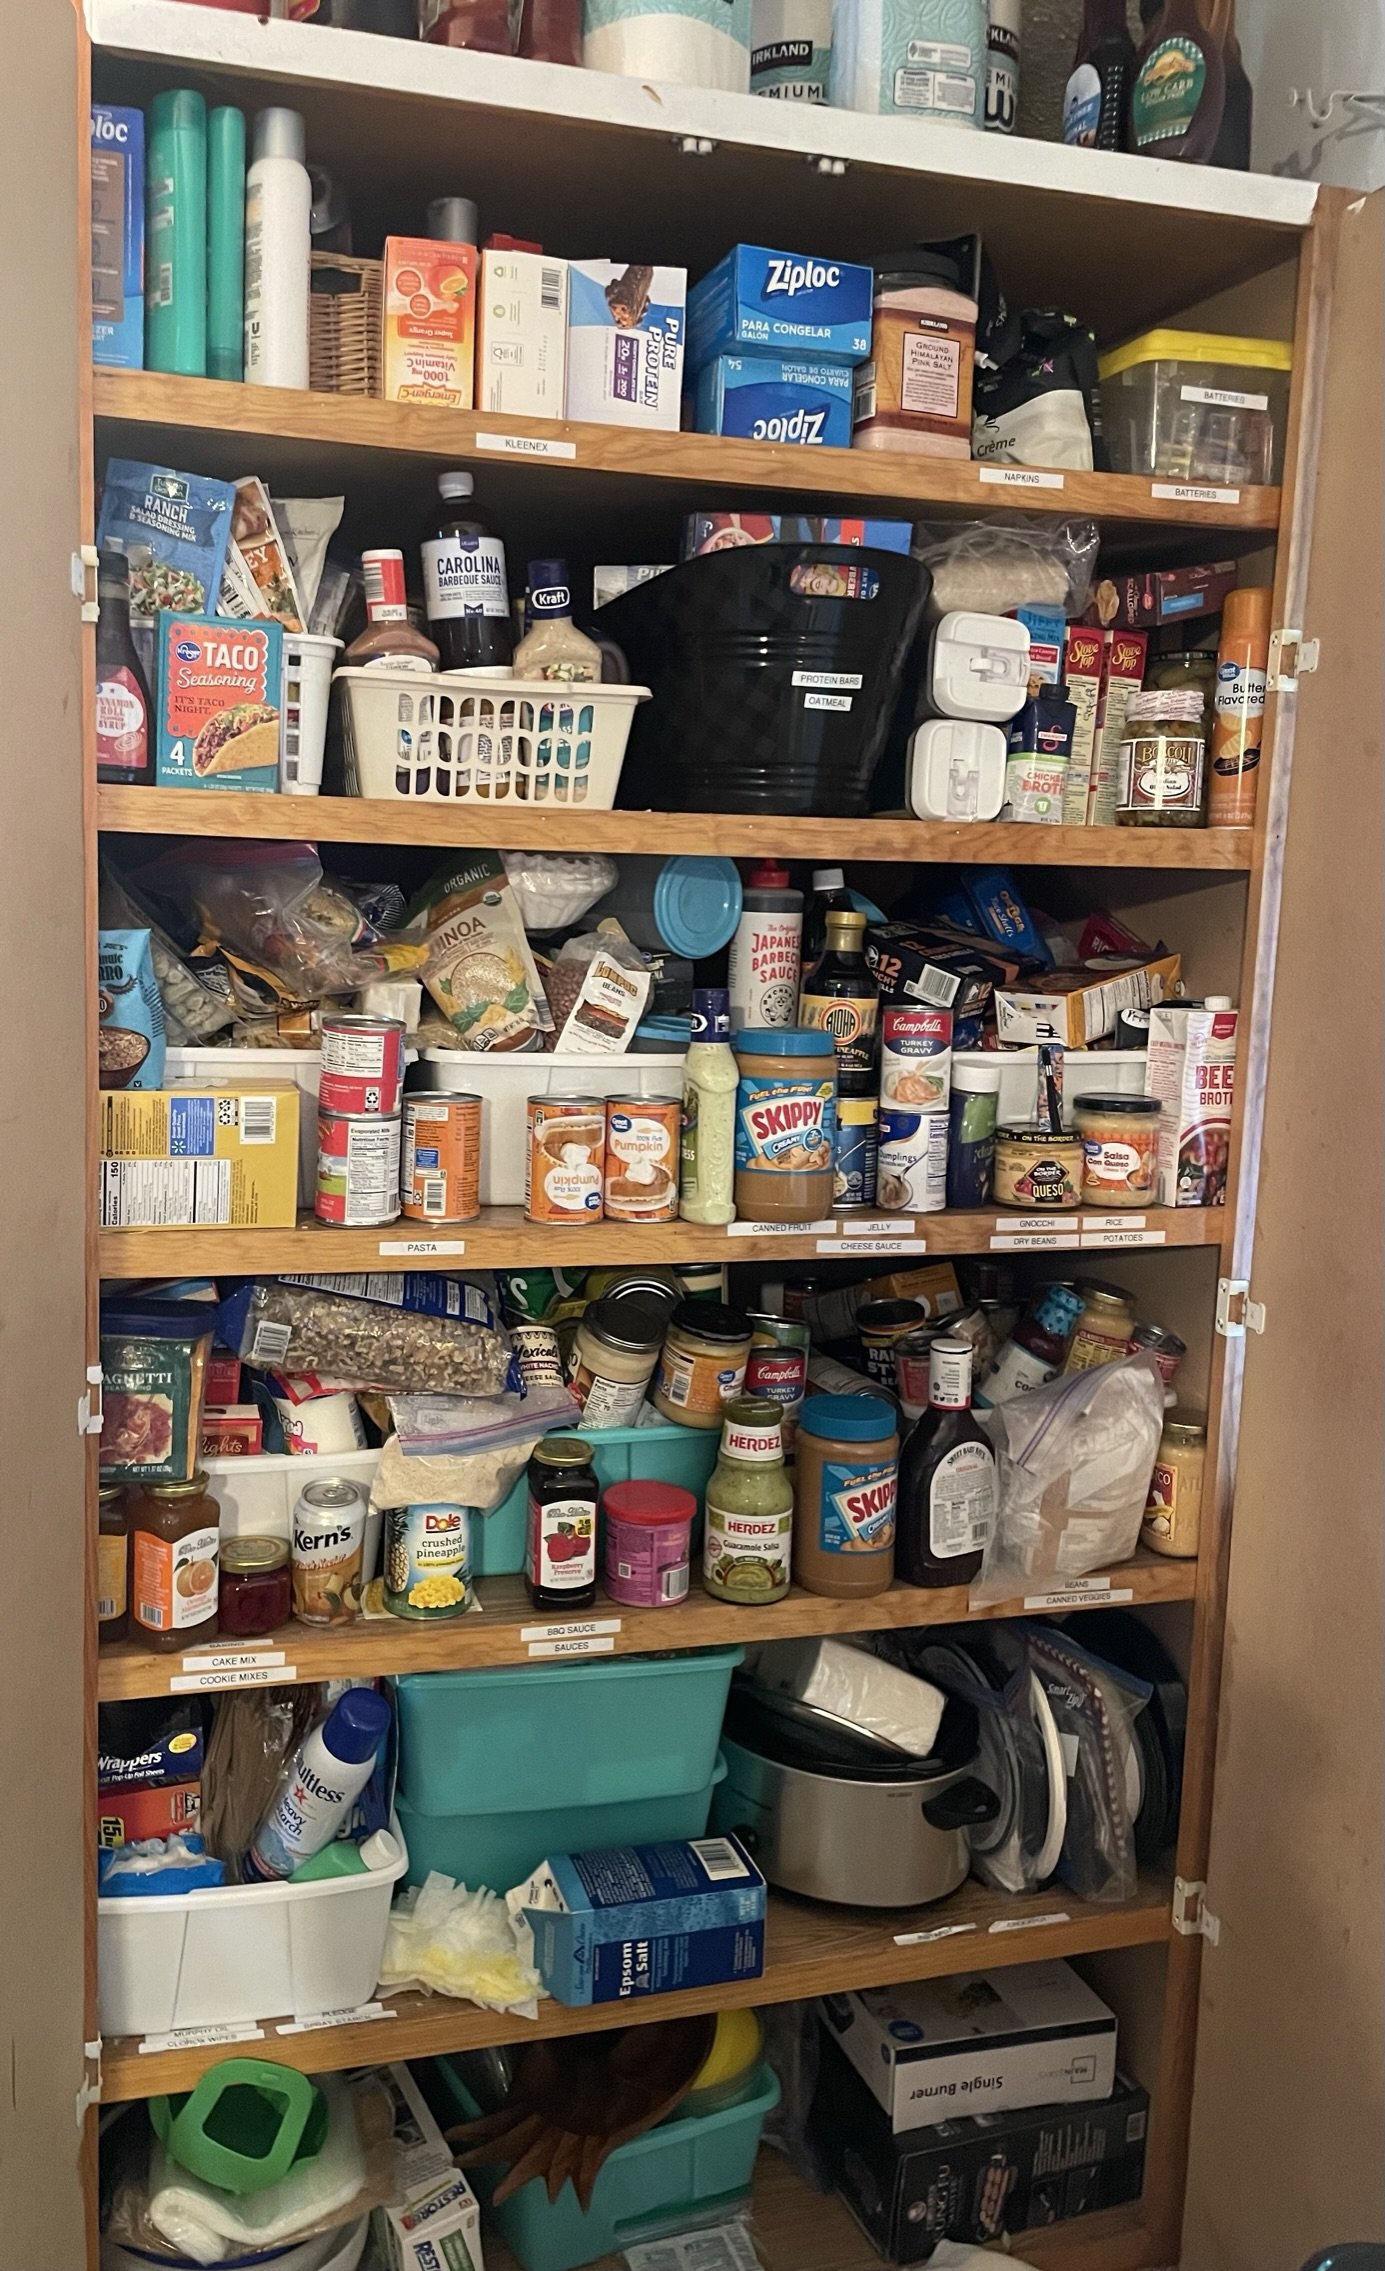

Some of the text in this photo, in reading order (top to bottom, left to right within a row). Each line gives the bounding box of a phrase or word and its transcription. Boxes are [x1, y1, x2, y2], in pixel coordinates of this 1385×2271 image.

[751, 41, 810, 66] IRKLAND
[766, 259, 840, 297] Ziploc
[741, 329, 769, 341] GALÓN
[742, 319, 832, 339] PARA CONGELAR
[662, 317, 680, 370] PURE
[852, 337, 867, 351] 38
[915, 341, 950, 354] GROUND
[910, 349, 953, 364] HIMALAYAN
[911, 357, 952, 371] PINK SALT
[406, 358, 456, 372] C Vitamin
[644, 326, 663, 408] PROTEIN
[728, 359, 743, 371] 54
[782, 371, 850, 388] CONGELAR PARA
[400, 388, 457, 403] Emergen-C
[1203, 391, 1246, 404] BATTERIES
[753, 409, 827, 446] Ziploc
[505, 439, 549, 452] KLEENEX
[976, 436, 1017, 458] Crème
[1004, 472, 1041, 485] NAPKINS
[1174, 487, 1218, 500] BATTERIES
[144, 494, 189, 523] RANCH
[130, 505, 195, 535] SALAD DRESSING
[136, 514, 180, 538] SEASONING
[181, 530, 197, 543] MIX
[437, 556, 501, 576] CAROLINA
[438, 574, 502, 588] BARBEQUE SAUCE
[538, 591, 567, 607] Kraft
[203, 641, 259, 671] TACO
[1069, 640, 1100, 663] Stove
[1111, 642, 1142, 665] Stove
[1079, 655, 1095, 669] Top
[1121, 658, 1137, 671] Top
[176, 668, 257, 695] Seasoning
[800, 674, 860, 687] PROTEIN BARS
[174, 696, 225, 708] IT'S TACO
[808, 696, 847, 708] OATMEAL
[98, 720, 126, 731] SYRUP
[170, 741, 186, 766] 4
[161, 766, 194, 778] PACKETS
[443, 863, 492, 894] ORGANIC
[879, 953, 903, 979] 12
[592, 960, 639, 998] LOMPOC
[760, 966, 798, 984] SAUCE
[602, 981, 627, 998] BEANS
[892, 1017, 944, 1034] Campbell's
[899, 1039, 935, 1048] TURKEY
[900, 1046, 934, 1055] GRAVY
[1195, 1065, 1235, 1090] BEE
[749, 1087, 770, 1101] FUEL
[751, 1101, 823, 1141] SKIPPY
[771, 1136, 801, 1154] CREAMY
[1021, 1134, 1075, 1143] ON THE BORDER
[613, 1139, 664, 1154] Pumpkin
[1087, 1158, 1130, 1168] Con Queso
[1103, 1151, 1130, 1161] Salsa
[110, 1161, 119, 1179] 150
[1033, 1170, 1063, 1178] BORDER
[552, 1172, 601, 1187] Pumpkin
[1032, 1183, 1065, 1199] QUESO
[111, 1196, 119, 1226] Calories
[752, 1222, 813, 1233] CANNED FRUIT
[866, 1223, 892, 1233] JELLY
[1019, 1218, 1056, 1228] GNOCCHI
[1105, 1217, 1124, 1227] RICE
[1013, 1236, 1058, 1246] DRY BEANS
[1103, 1232, 1144, 1243] POTATOES
[407, 1242, 438, 1253] PASTA
[840, 1241, 903, 1251] CHEESE SAUCE
[728, 1433, 781, 1452] HERDEZ
[425, 1514, 461, 1532] Dole
[727, 1520, 777, 1536] HERDEZ
[293, 1525, 353, 1552] Kern's
[421, 1534, 464, 1548] crushed
[723, 1539, 781, 1552] Guacamole Salsa
[416, 1543, 466, 1560] pineapple
[551, 1563, 585, 1572] Raspberry
[1064, 1580, 1090, 1590] BEANS
[1046, 1591, 1112, 1605] CANNED VEGGIES
[547, 1622, 597, 1636] BBQ SAUCE
[554, 1640, 590, 1652] SAUCES
[211, 1656, 257, 1667] CAKE MIX
[199, 1671, 269, 1686] COOKIE MIXES
[111, 1767, 166, 1782] Pop-Up Foil Sheets
[635, 1940, 649, 1973] Salt
[619, 1942, 636, 1996] Epsom
[321, 2007, 357, 2018] PLEDGE
[303, 2018, 335, 2030] SPRAY
[909, 2075, 1004, 2101] Burner Single
